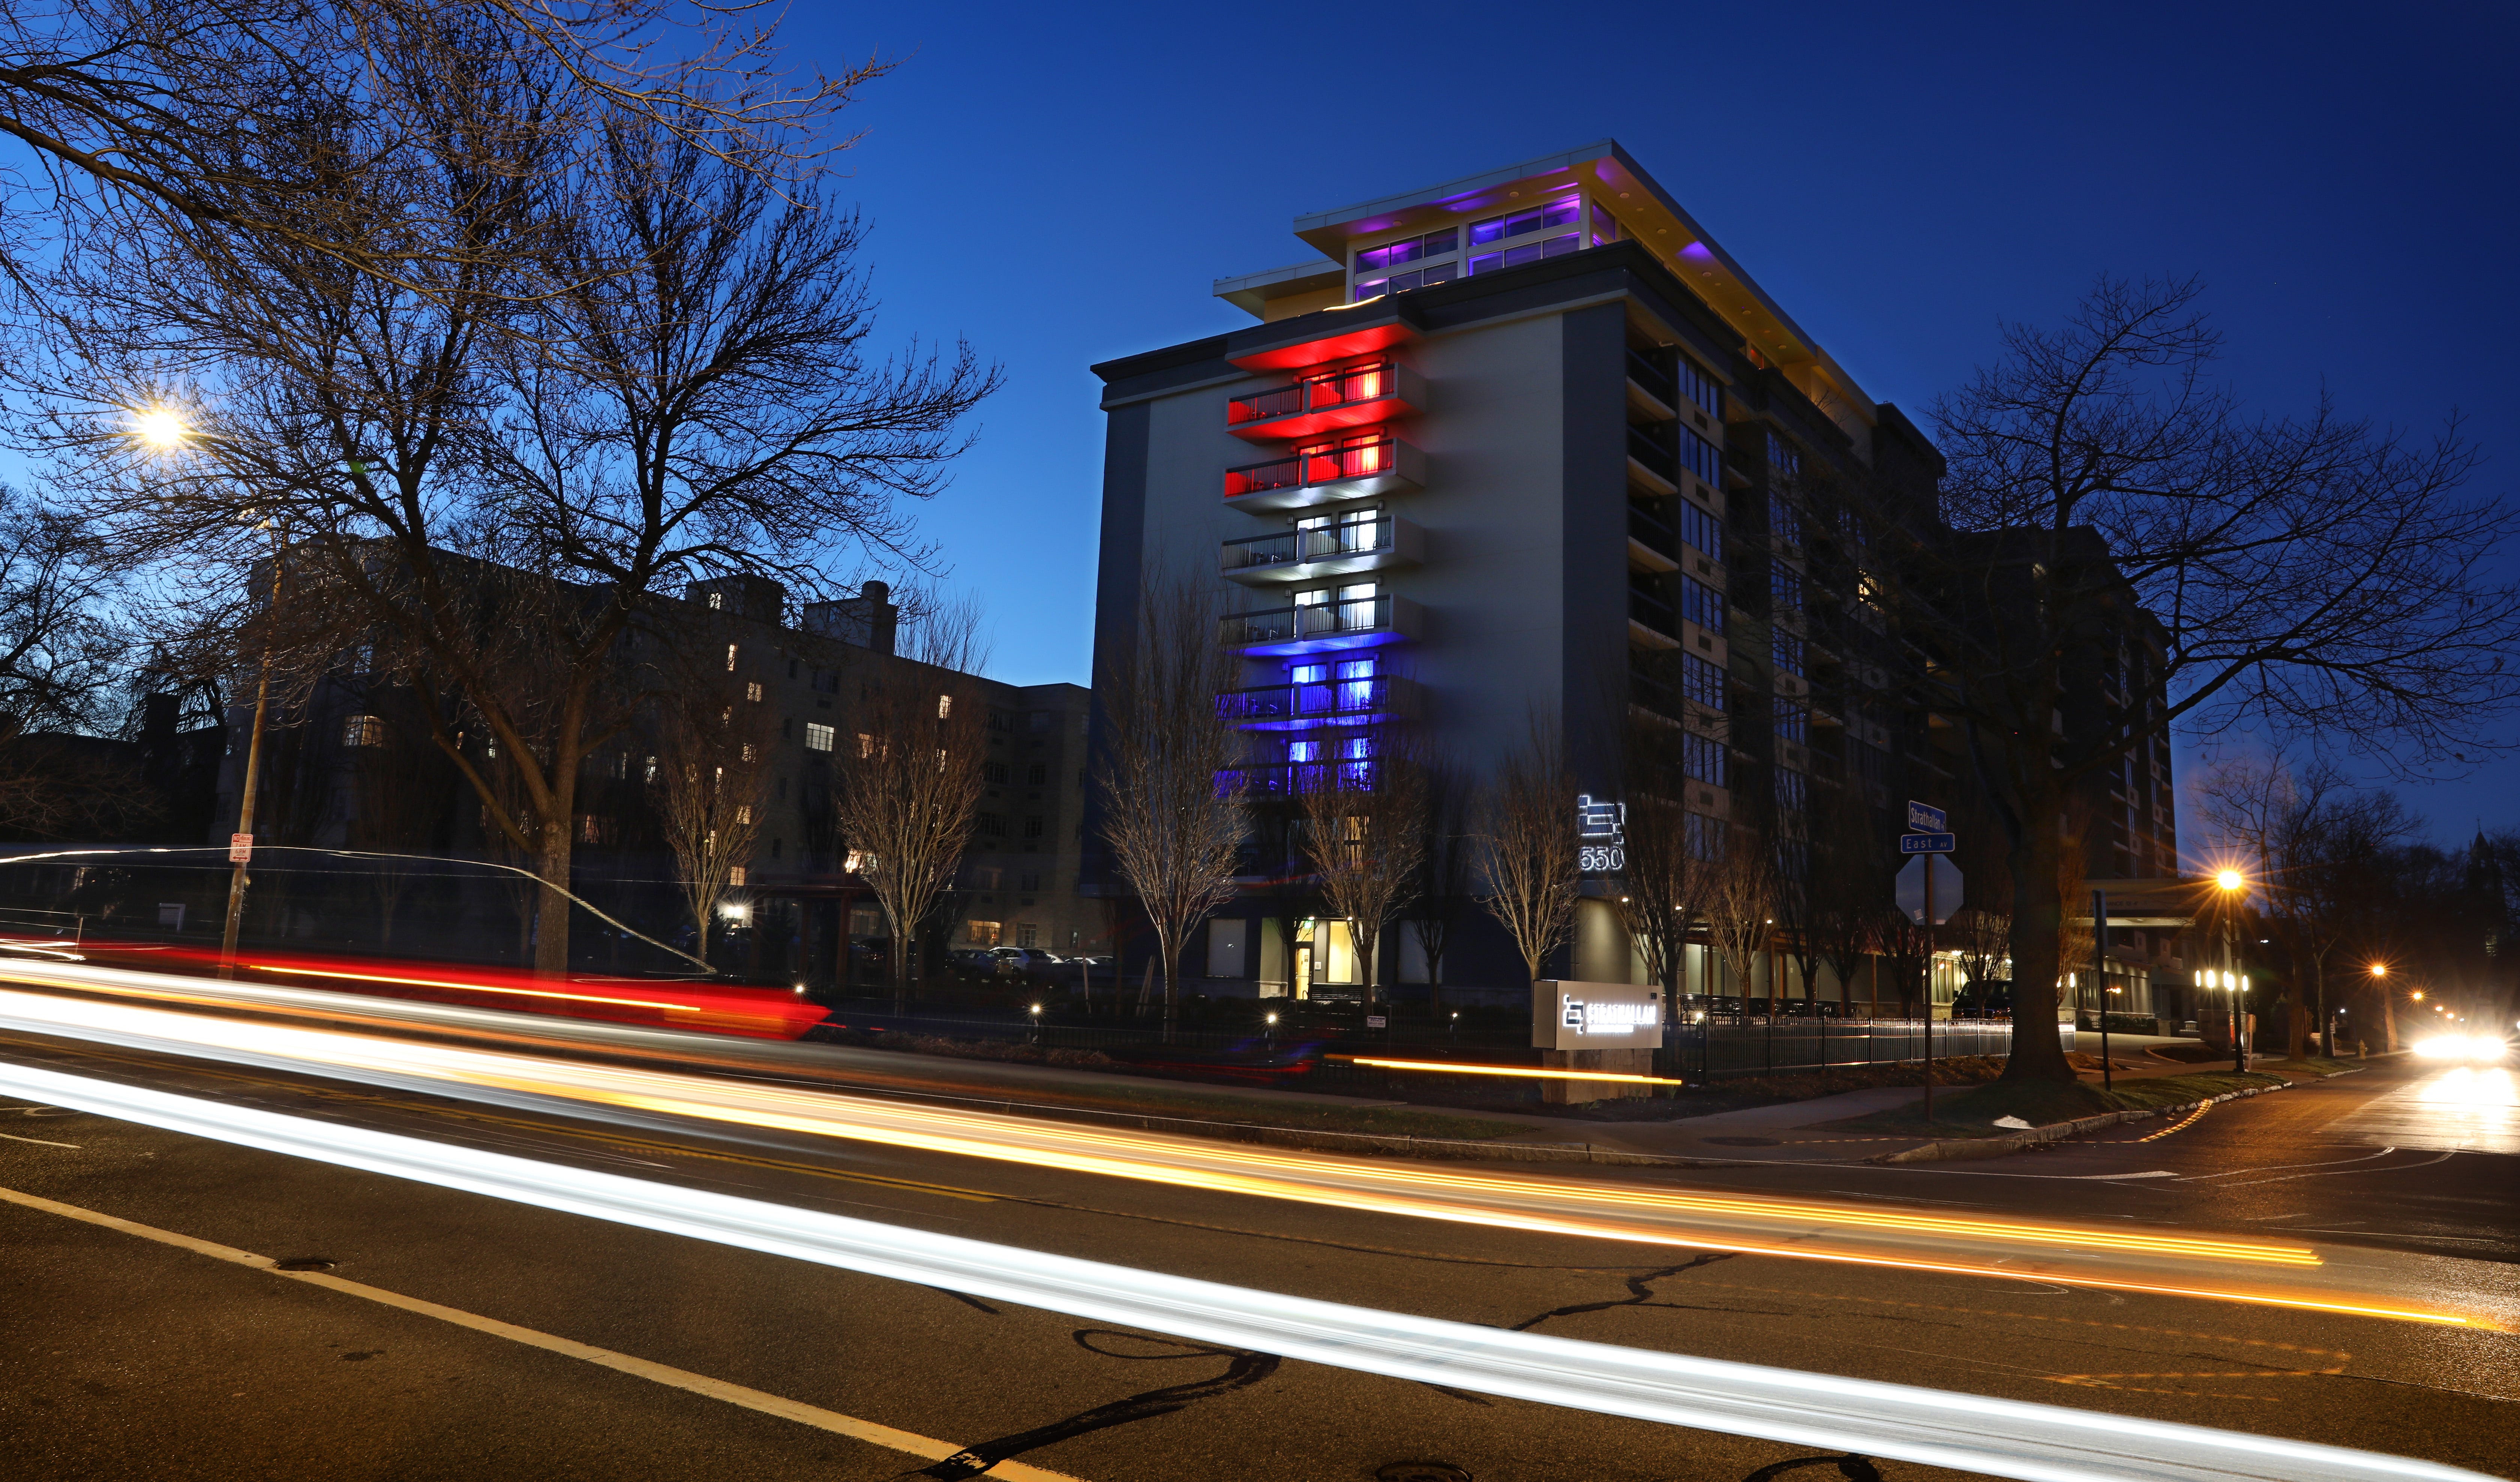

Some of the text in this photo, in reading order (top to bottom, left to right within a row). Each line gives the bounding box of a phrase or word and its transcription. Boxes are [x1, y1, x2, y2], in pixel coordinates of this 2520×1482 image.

[1911, 807, 1940, 830] Strathallan
[1906, 838, 1932, 849] East
[1579, 847, 1622, 869] 550
